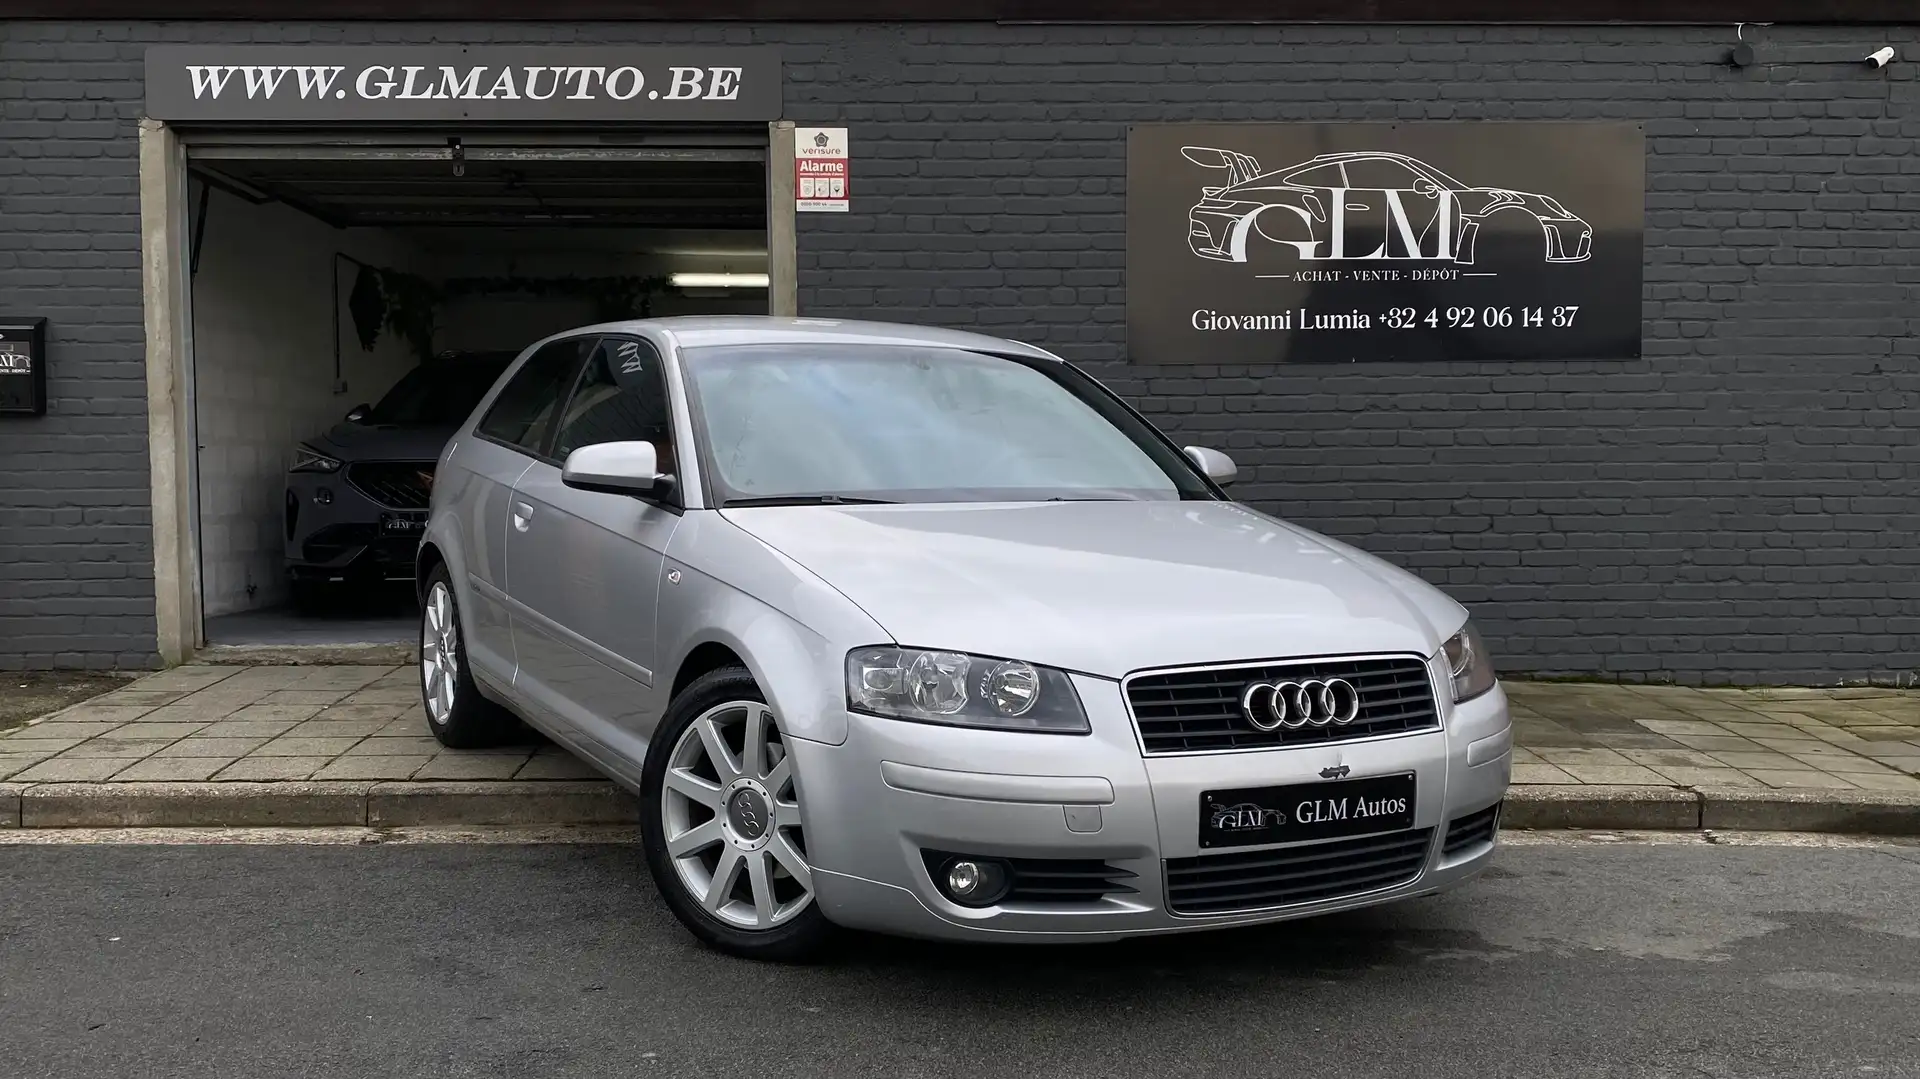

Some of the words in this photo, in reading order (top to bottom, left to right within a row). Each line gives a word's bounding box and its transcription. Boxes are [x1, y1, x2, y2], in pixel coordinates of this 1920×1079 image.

[186, 65, 743, 100] WWW.GLMAUTO.BE
[802, 147, 842, 155] verisure
[800, 160, 844, 172] Alarme
[1231, 188, 1458, 263] GLM
[1292, 270, 1342, 282] ACHAT
[1353, 269, 1400, 282] VENTE
[1411, 267, 1460, 281] DÉPÔT
[1191, 309, 1291, 331] Giovanni
[1299, 308, 1371, 330] Lumia
[1379, 307, 1416, 329] +32
[1424, 307, 1439, 329] 4
[1446, 307, 1476, 329] 92
[1483, 306, 1513, 328] 06
[1522, 306, 1544, 328] 14
[1551, 306, 1580, 328] 37
[1296, 798, 1348, 824] GLM
[1353, 796, 1406, 818] Autos
